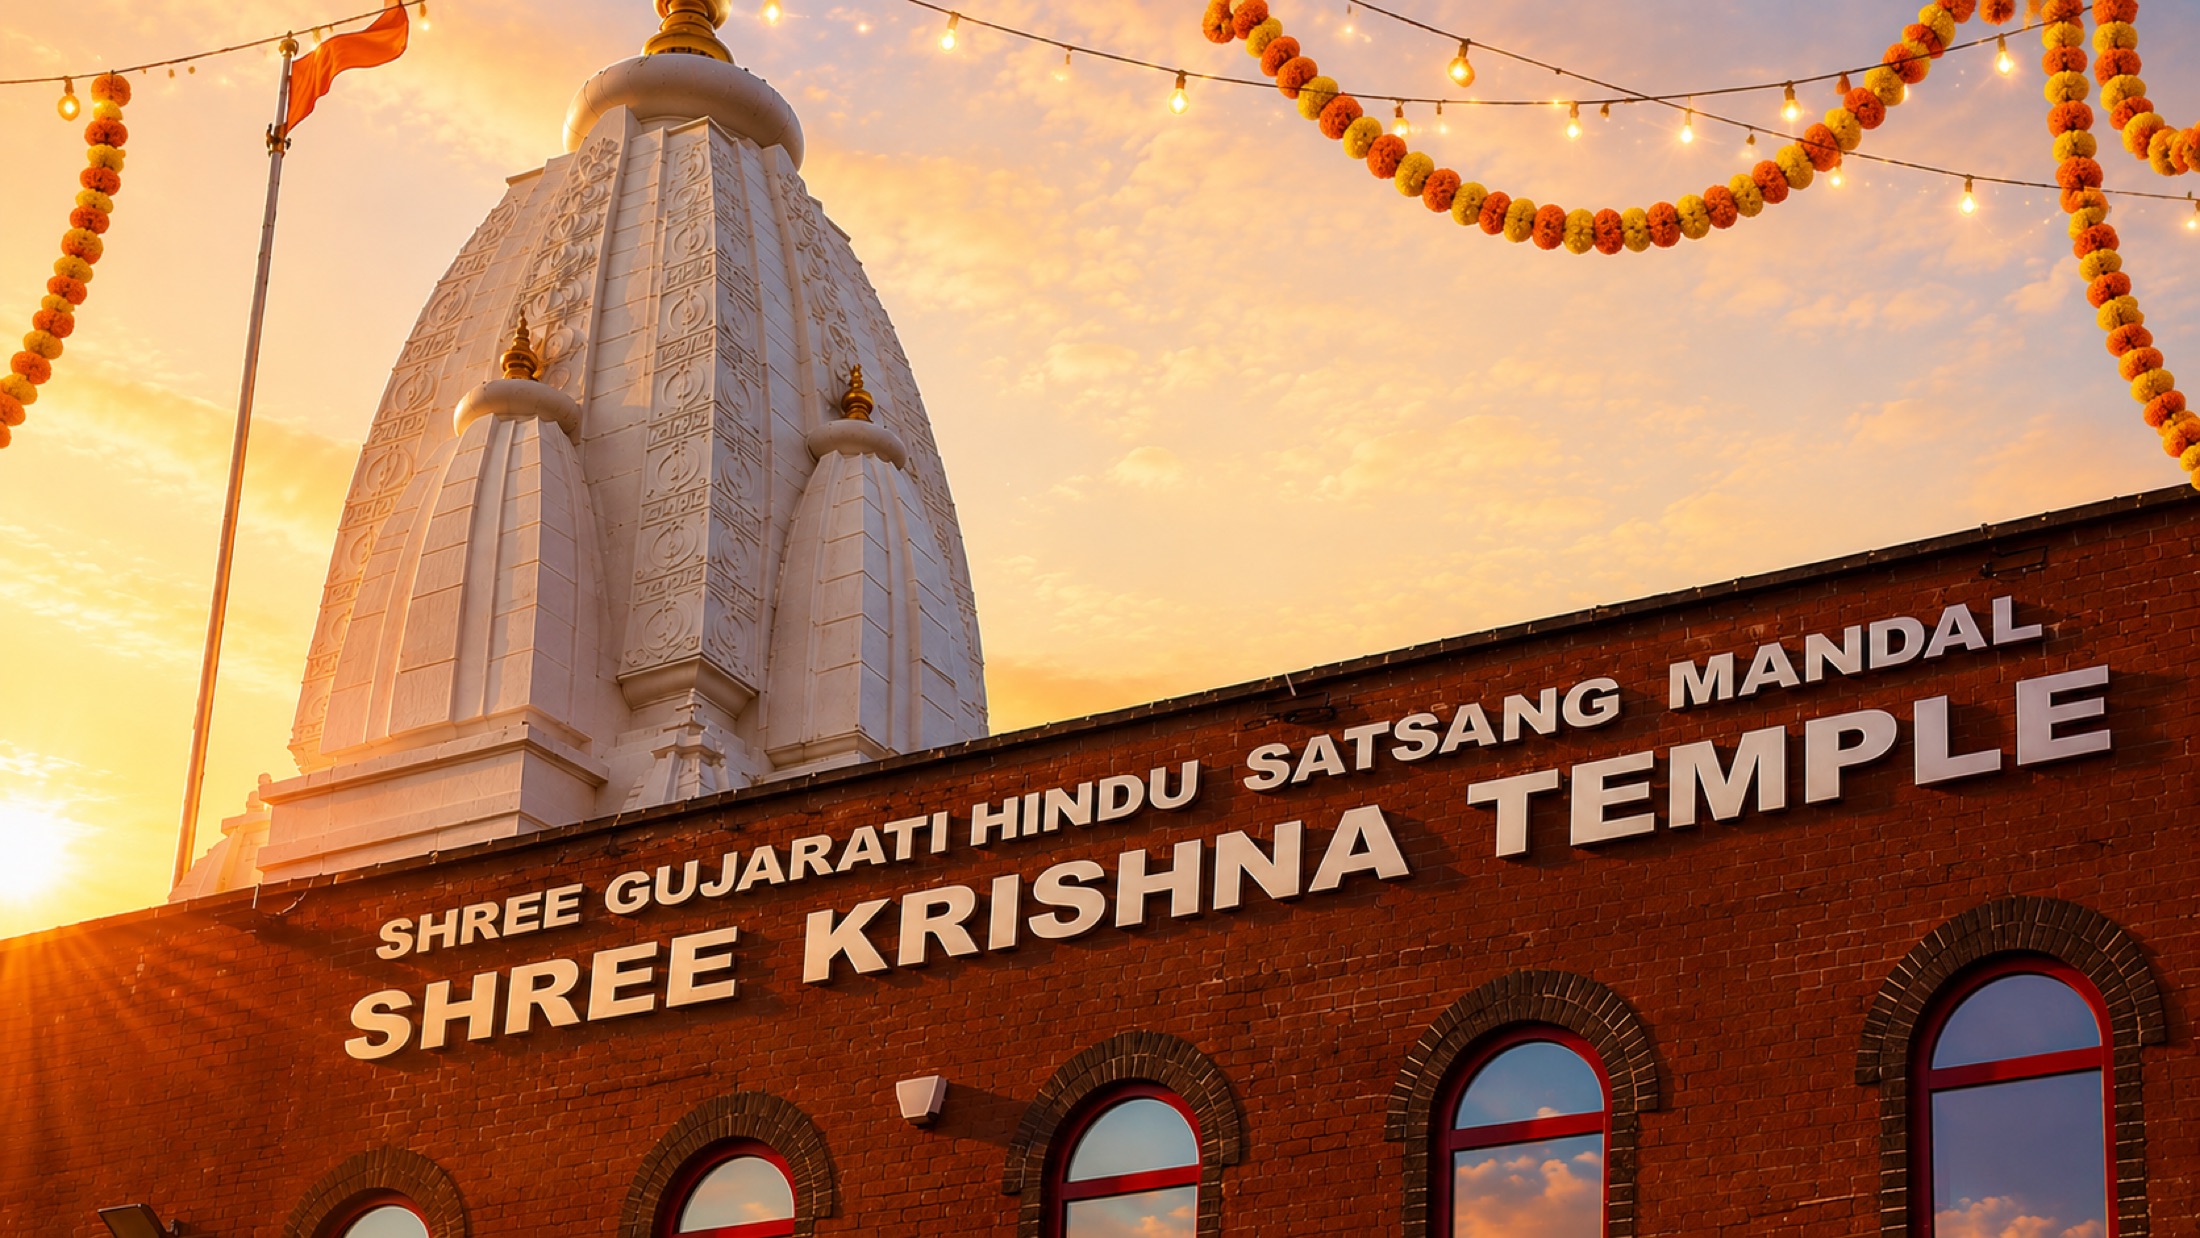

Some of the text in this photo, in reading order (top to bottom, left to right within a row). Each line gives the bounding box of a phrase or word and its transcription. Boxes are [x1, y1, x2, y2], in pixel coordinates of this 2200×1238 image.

[344, 664, 2112, 1059] SHREE KRISHNA TEMPLE
[375, 595, 2043, 959] SHREE GUJARATI HINDU SATSANG MANDAL
